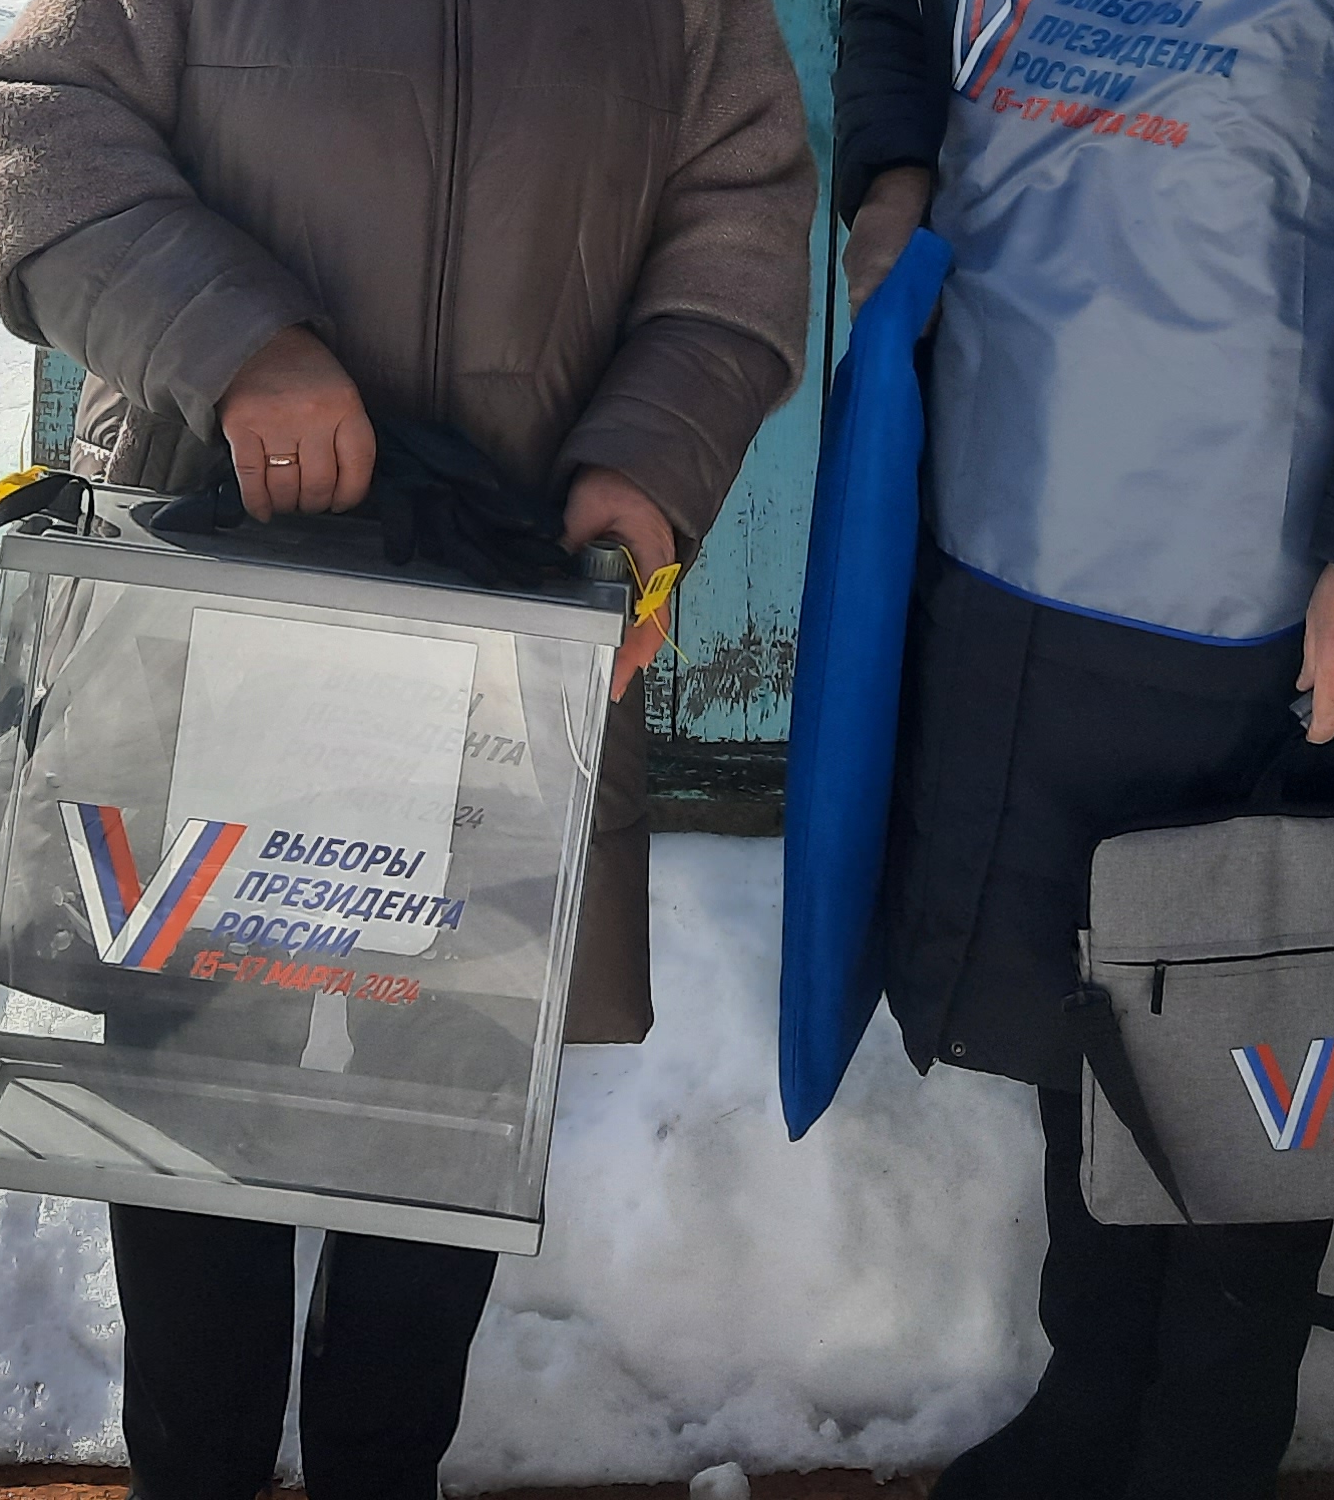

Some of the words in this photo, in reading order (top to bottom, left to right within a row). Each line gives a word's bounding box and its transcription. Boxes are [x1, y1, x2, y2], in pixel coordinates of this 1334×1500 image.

[1028, 14, 1239, 78] ПРЕЗИДЕНТА
[1007, 50, 1137, 102] РОССИИ
[1125, 112, 1191, 148] 2024
[258, 829, 427, 879] ВЫБОРЫ
[233, 870, 466, 930] ПРЕЗИДЕНТА
[210, 911, 363, 957] РОССИИ
[262, 959, 357, 996] МАРТА
[354, 972, 421, 1005] 2024
